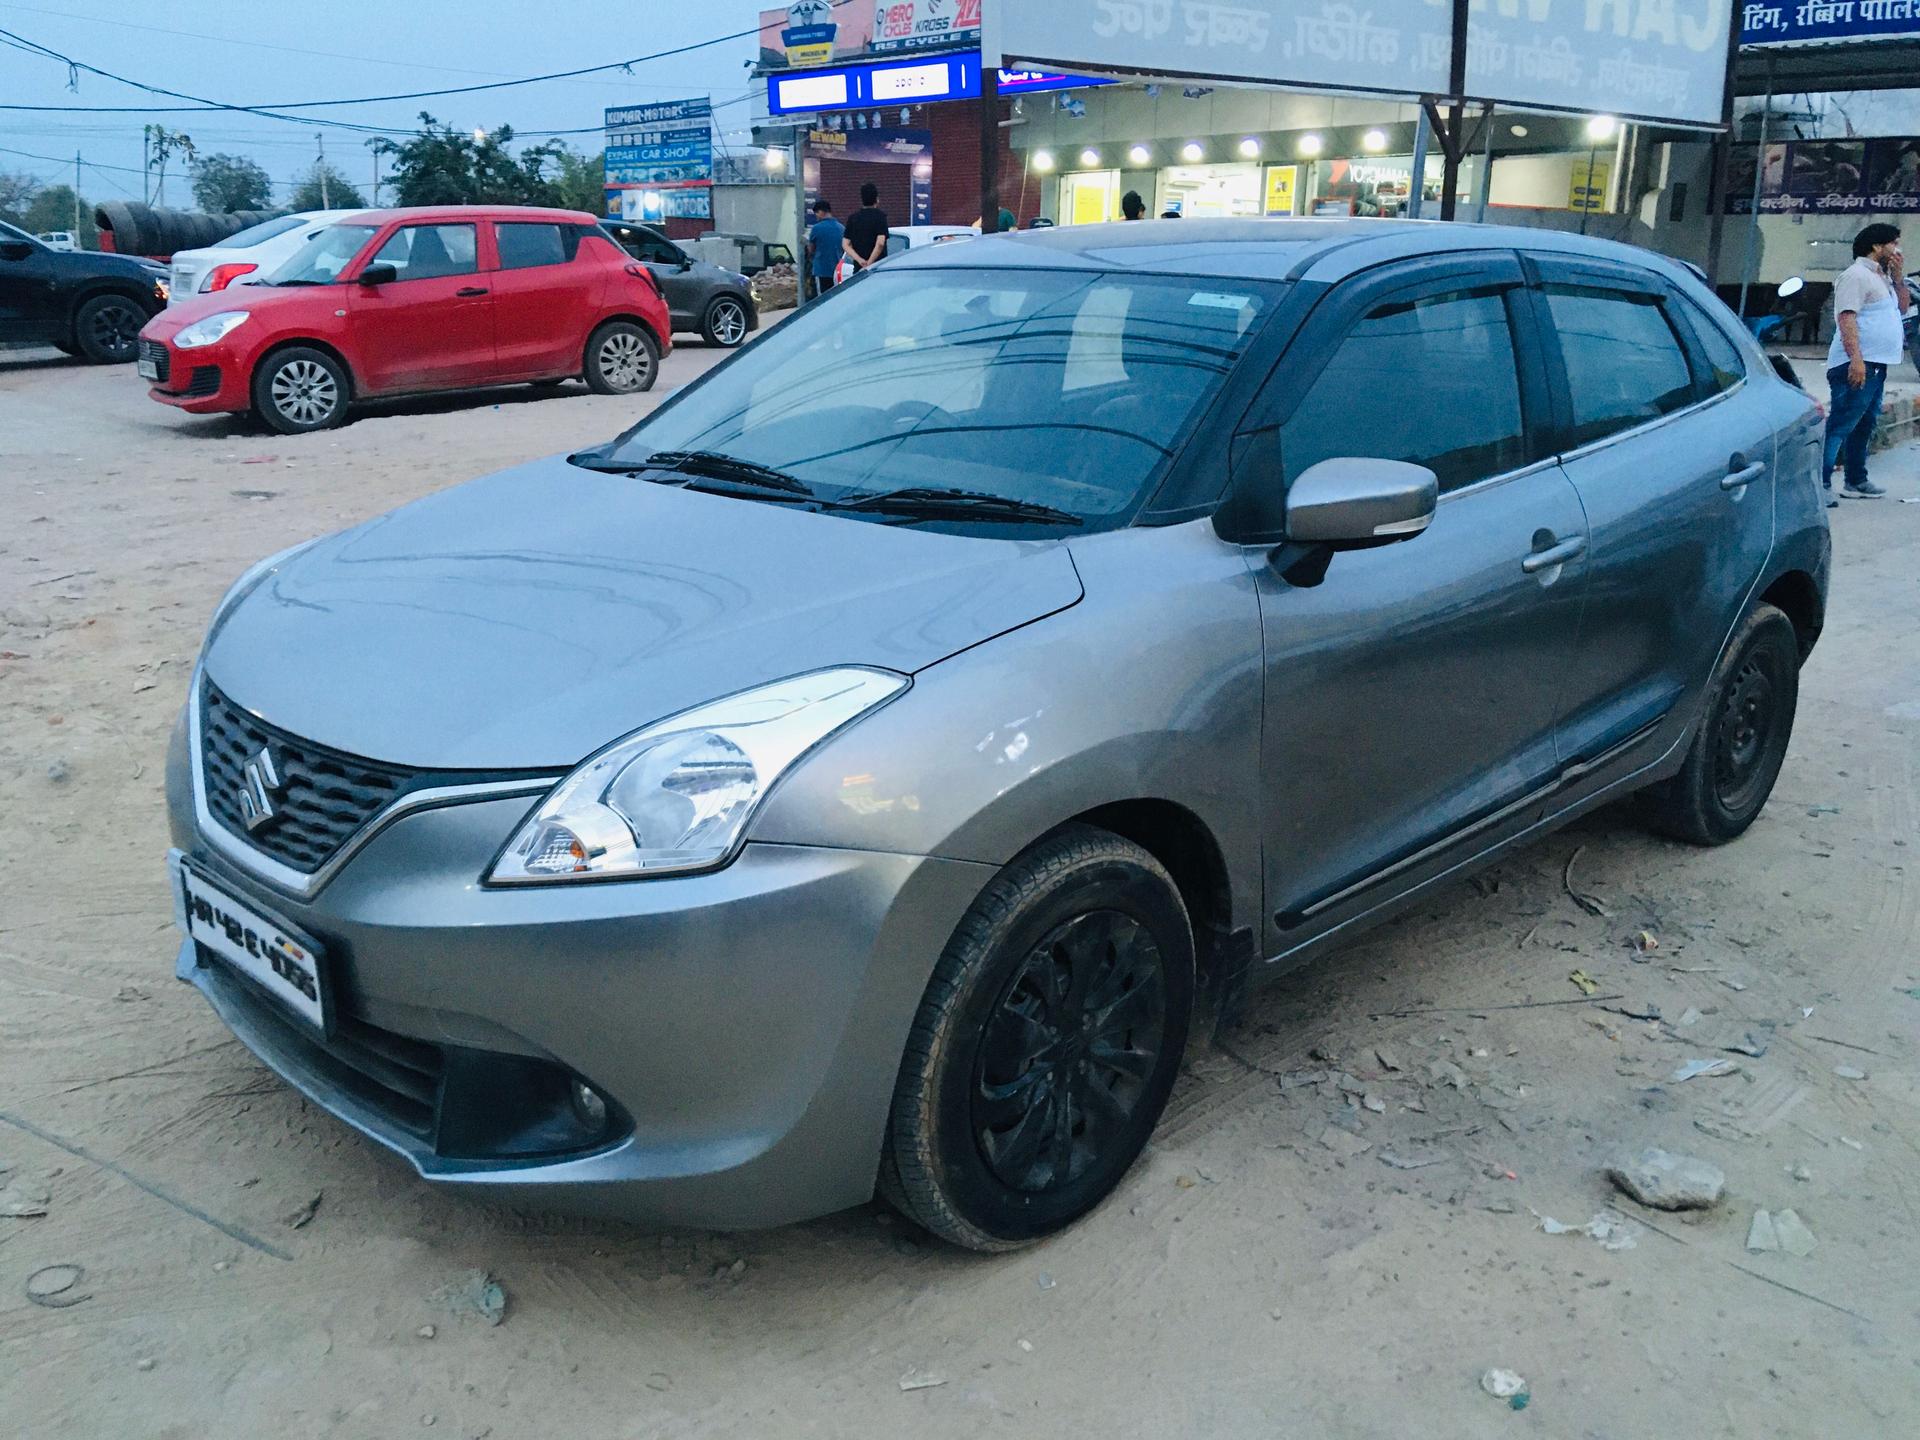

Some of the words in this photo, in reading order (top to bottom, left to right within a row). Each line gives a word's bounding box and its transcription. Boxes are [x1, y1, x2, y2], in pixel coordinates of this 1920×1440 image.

[885, 3, 914, 24] HERO
[883, 22, 911, 38] CYCLES
[915, 16, 950, 33] KROSS
[904, 33, 961, 47] CYCLE
[641, 148, 660, 159] CAR
[663, 146, 690, 159] SHOP
